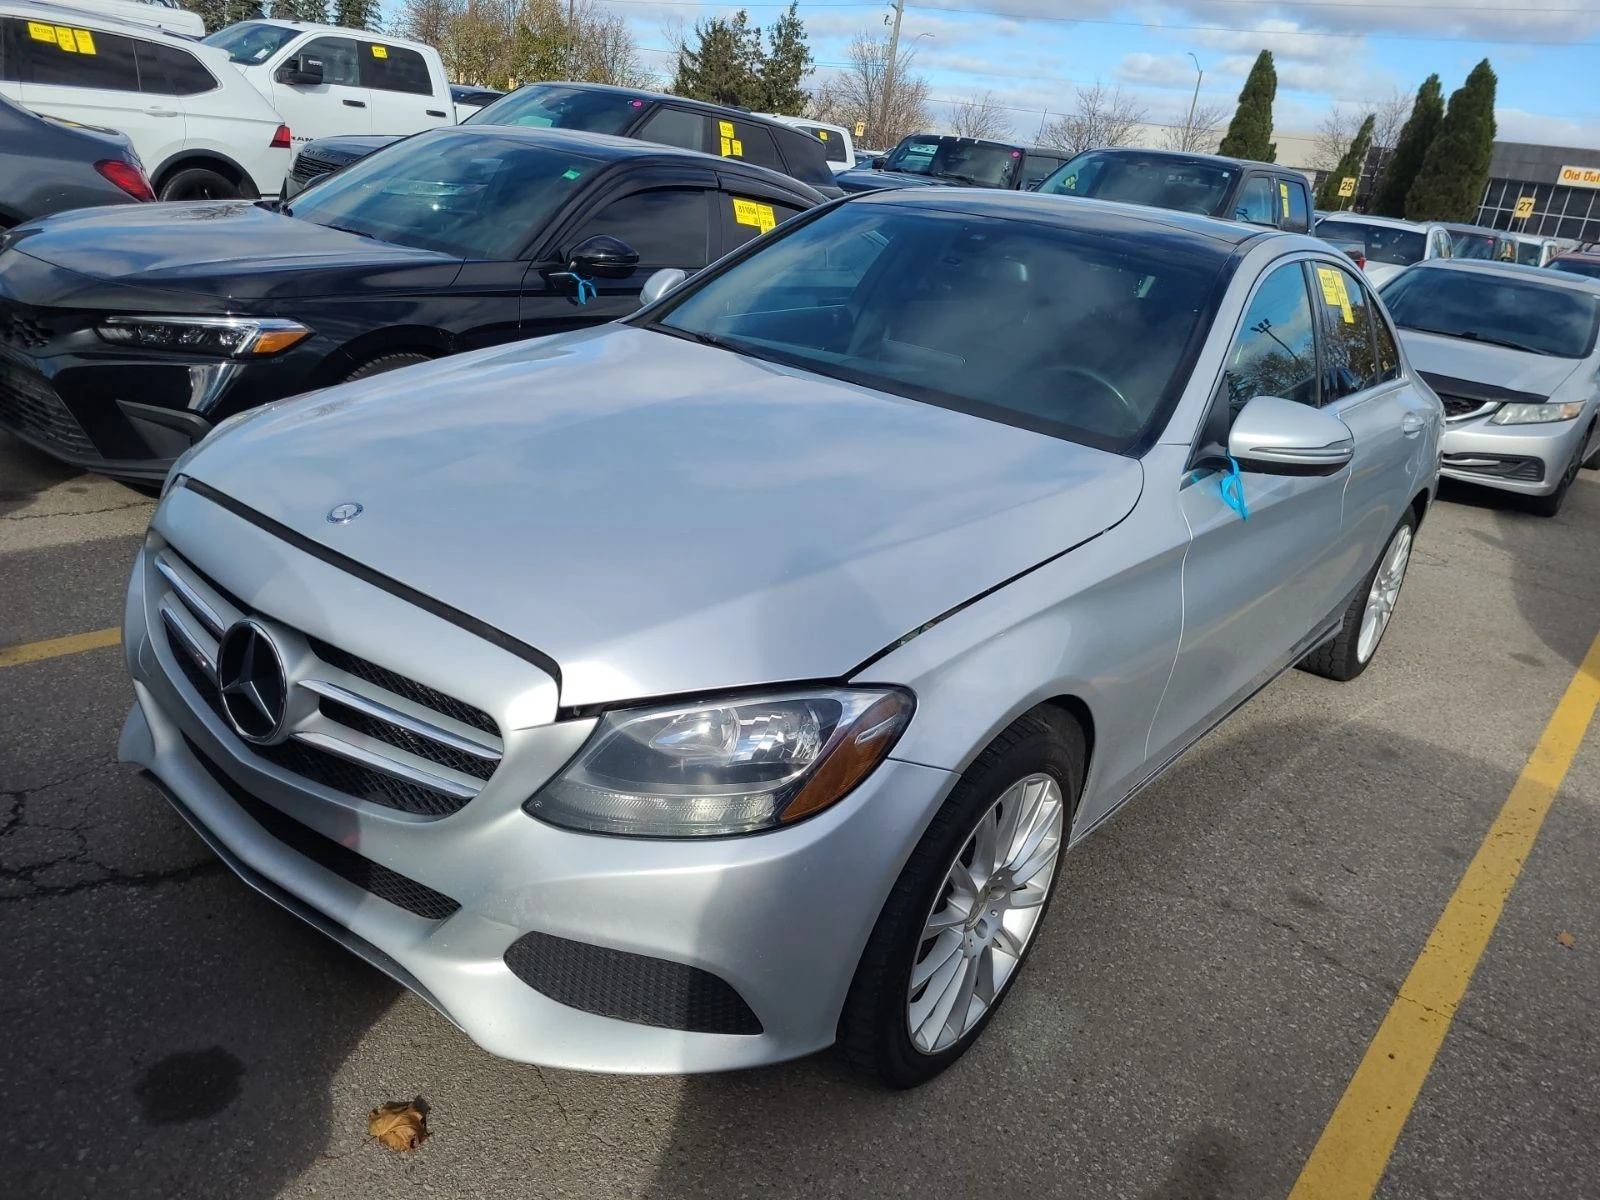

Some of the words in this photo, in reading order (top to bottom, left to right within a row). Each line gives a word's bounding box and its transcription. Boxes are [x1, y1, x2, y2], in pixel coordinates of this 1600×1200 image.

[1563, 169, 1581, 181] Old
[1341, 181, 1353, 191] 25
[1518, 201, 1533, 212] 27
